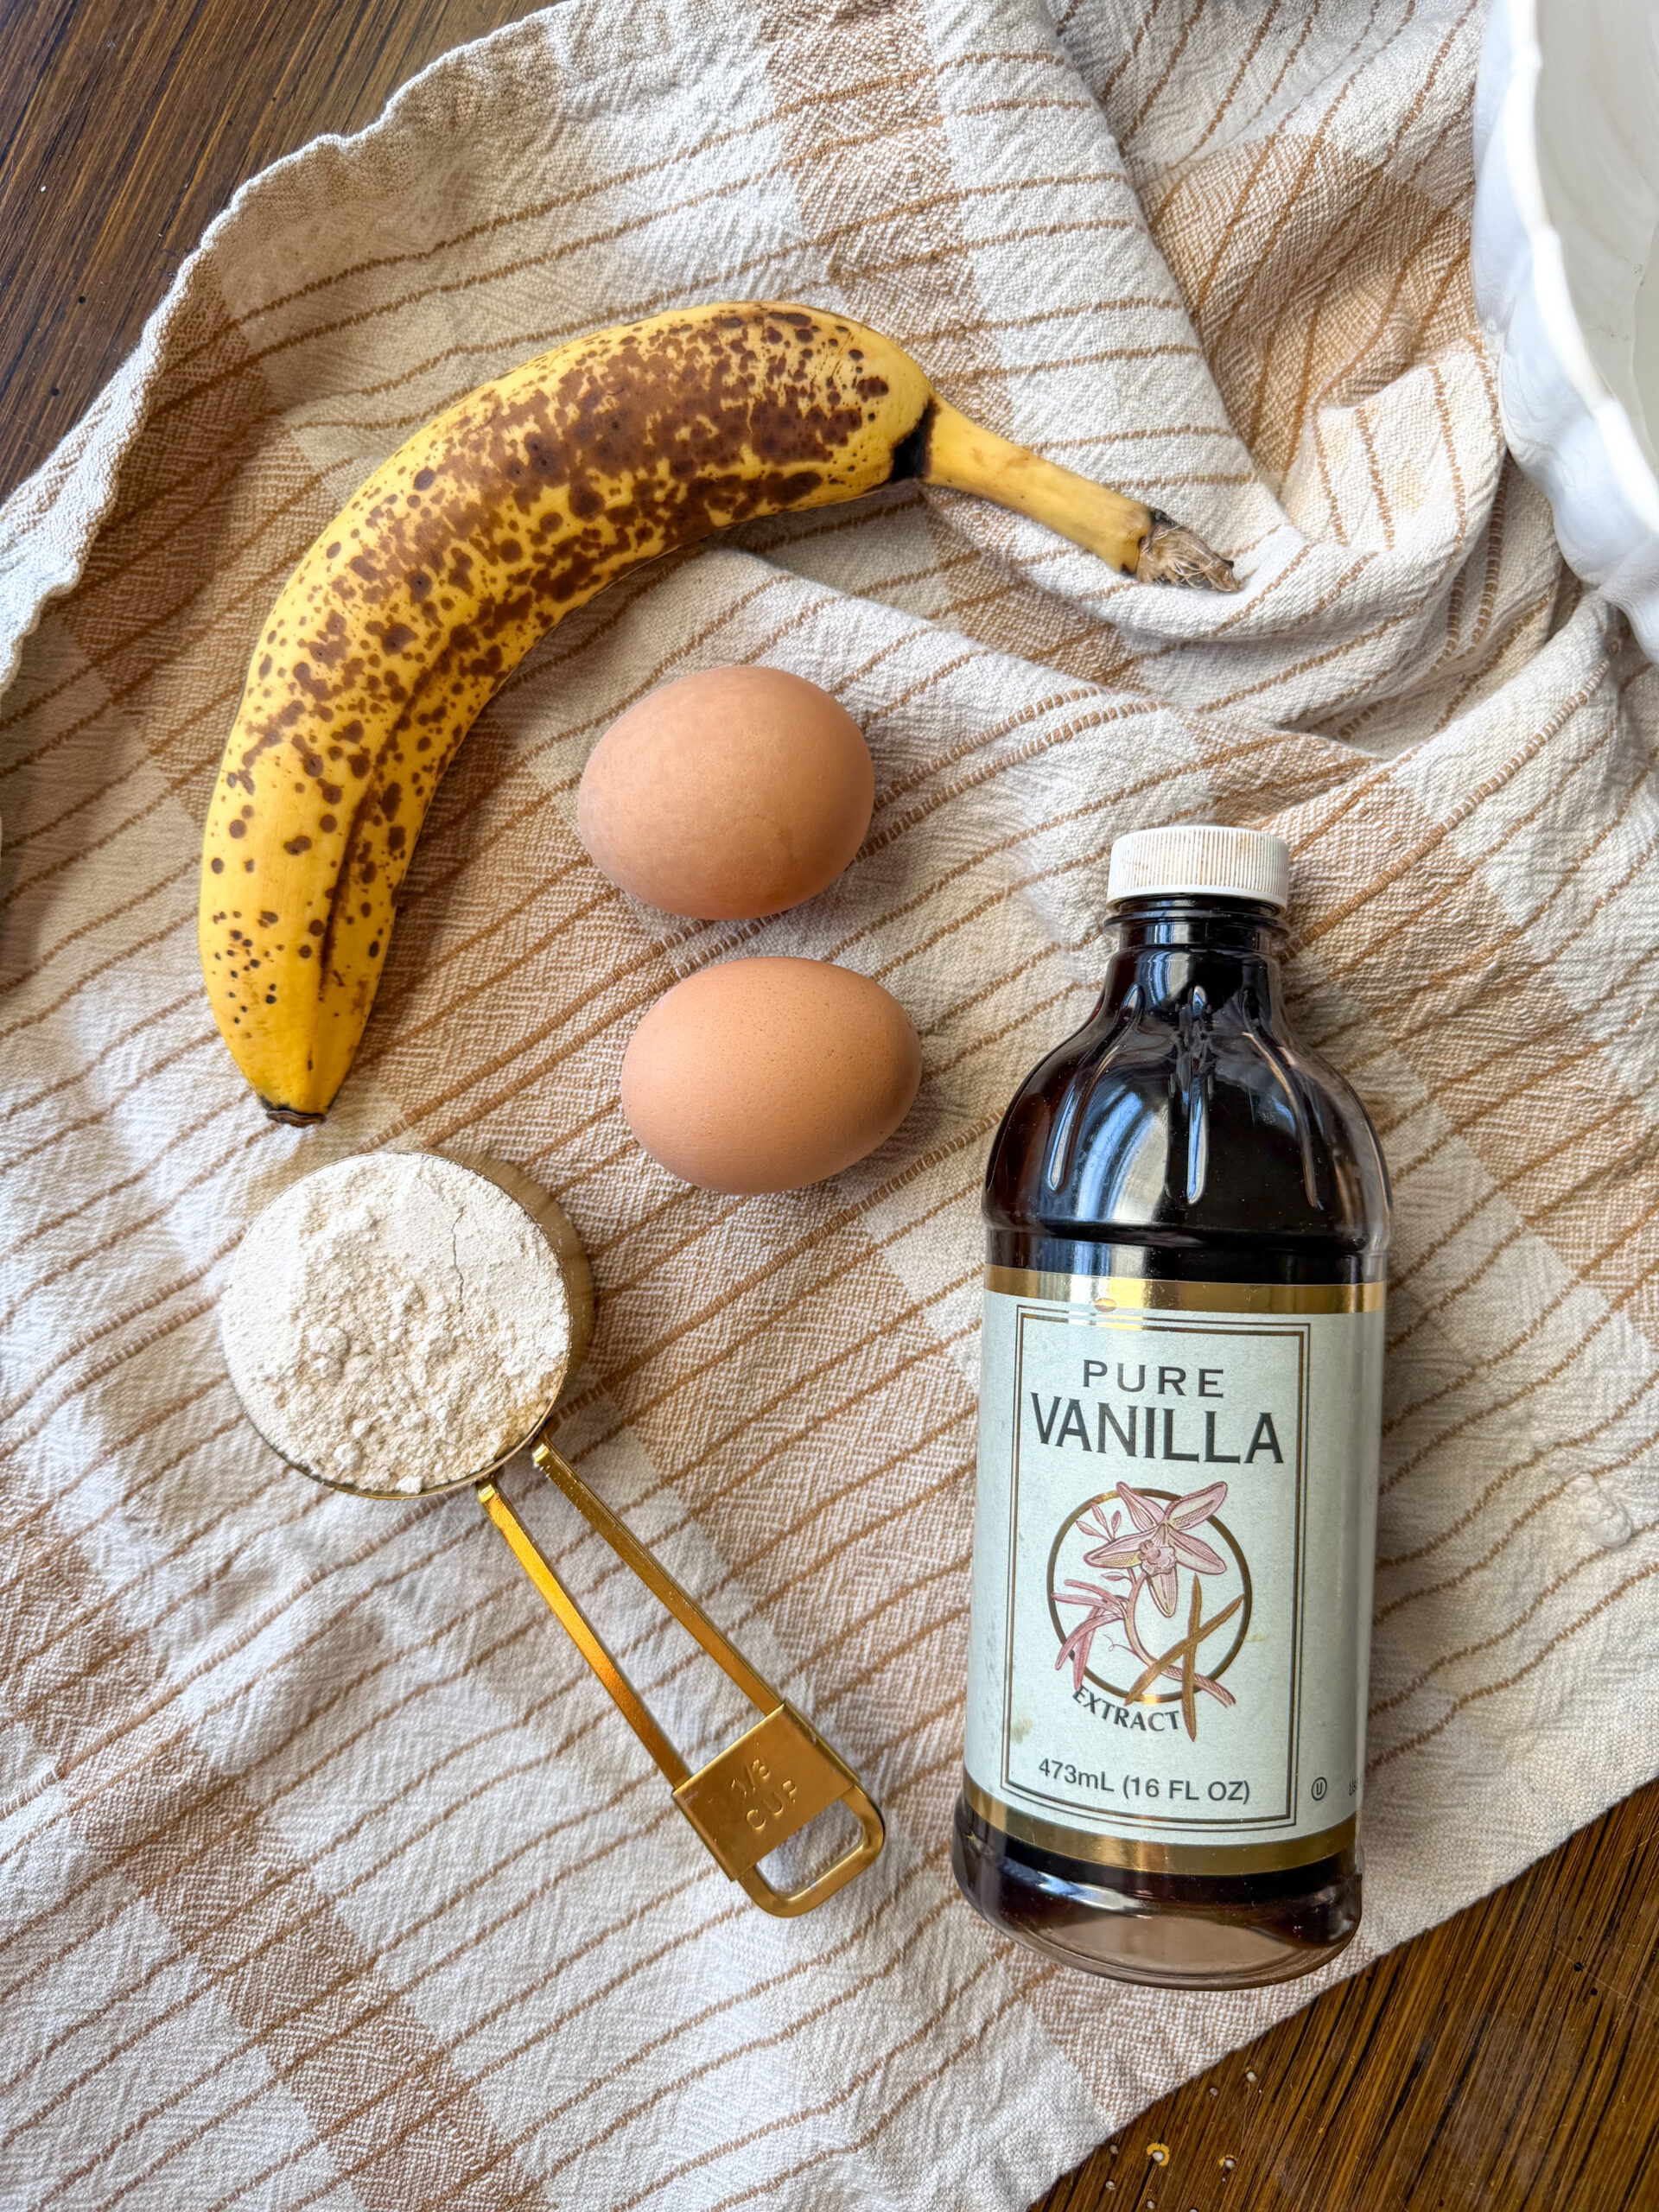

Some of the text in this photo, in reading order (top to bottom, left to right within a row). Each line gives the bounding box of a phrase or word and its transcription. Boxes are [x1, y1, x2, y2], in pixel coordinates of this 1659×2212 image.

[1083, 1359, 1224, 1399] PURE
[1030, 1392, 1284, 1465] VANILLA
[1072, 1684, 1179, 1732] EXTRACT
[746, 1779, 797, 1831] CUP
[1038, 1758, 1250, 1805] 473mL (16 FL OZ)
